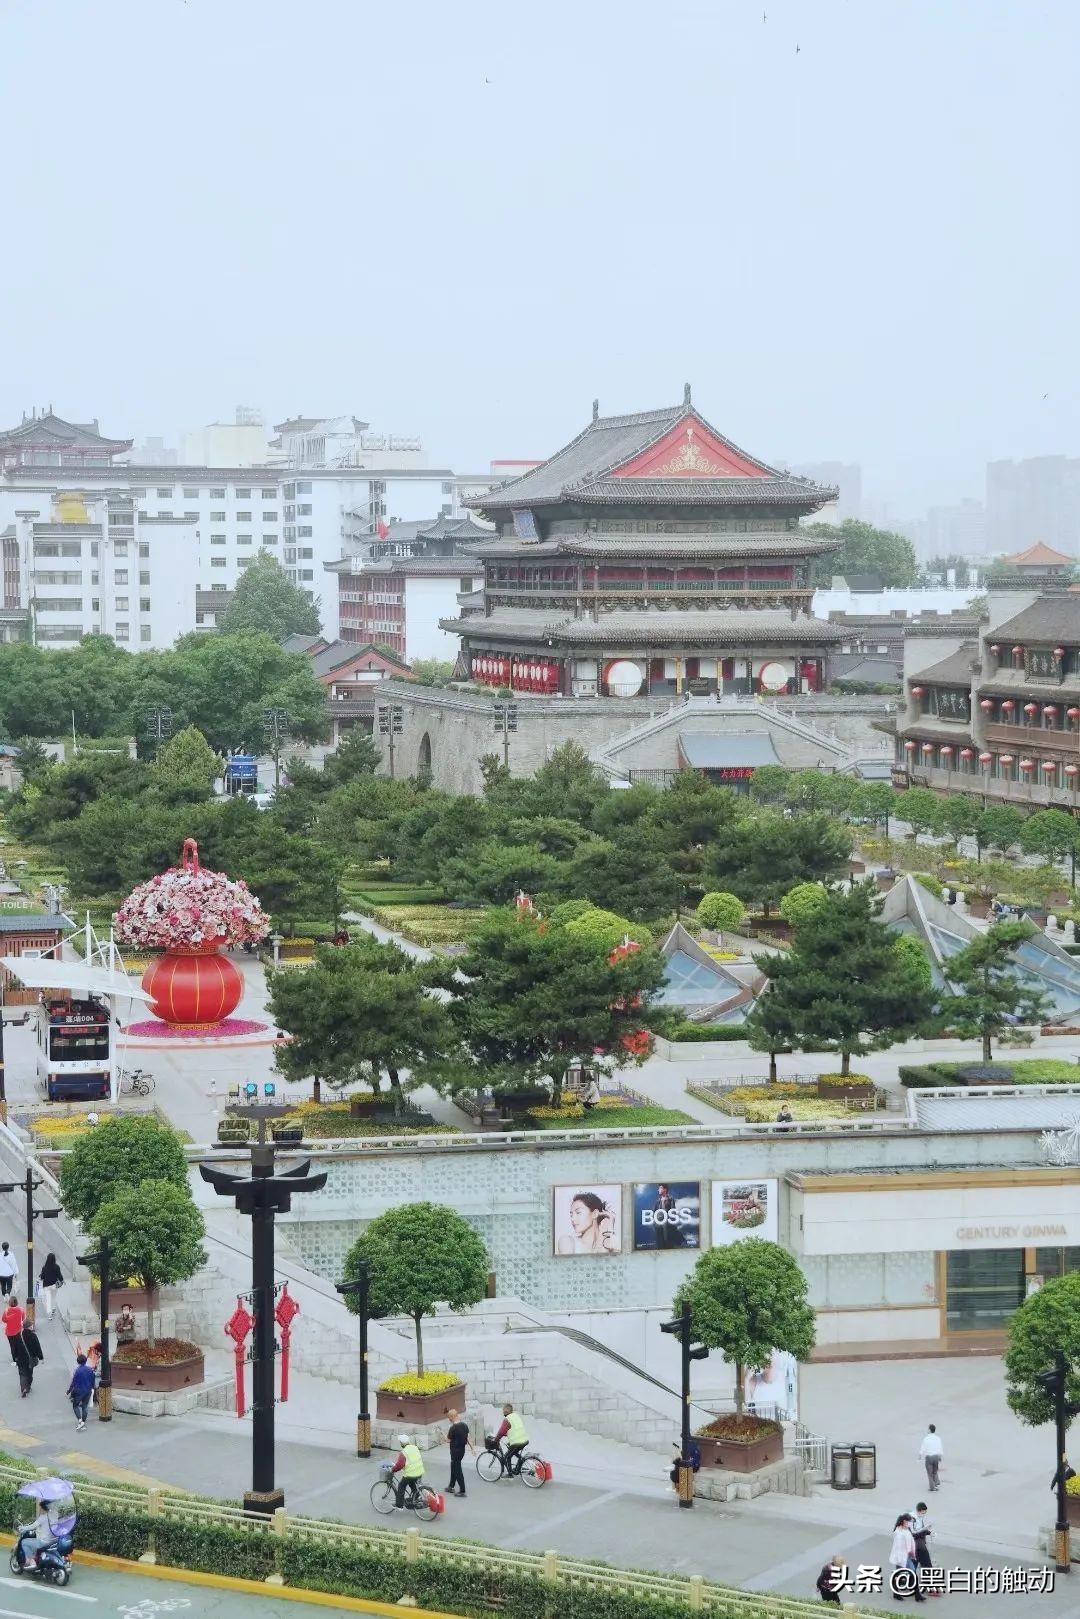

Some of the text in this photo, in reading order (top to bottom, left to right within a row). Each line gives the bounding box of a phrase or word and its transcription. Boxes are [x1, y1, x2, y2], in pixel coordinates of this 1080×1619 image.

[2, 901, 35, 909] TOILET
[641, 1207, 692, 1226] BOSS
[956, 1225, 1019, 1240] CENTURY
